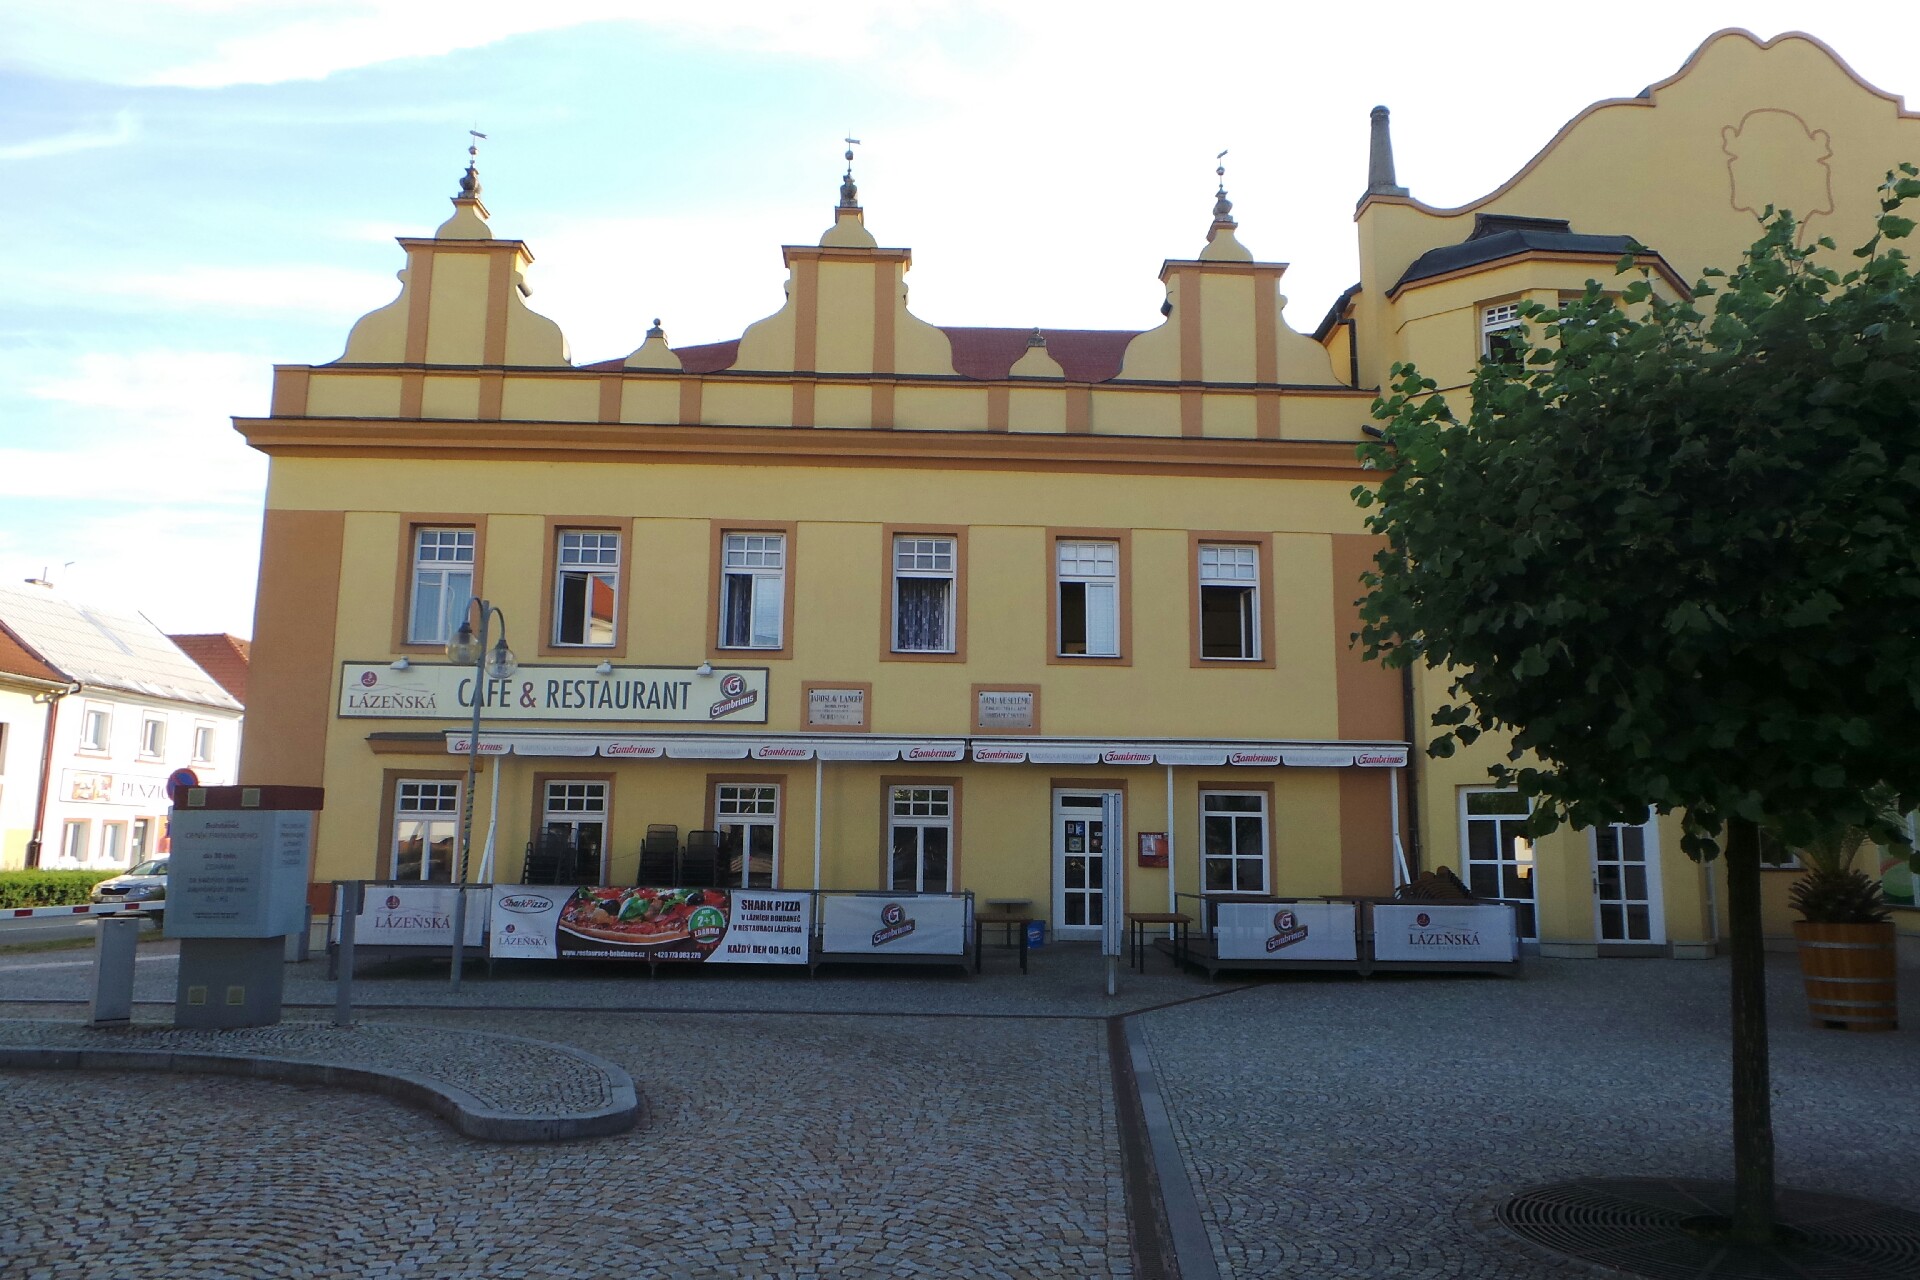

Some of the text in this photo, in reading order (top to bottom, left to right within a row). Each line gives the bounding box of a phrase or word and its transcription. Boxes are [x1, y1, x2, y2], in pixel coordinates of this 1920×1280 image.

[519, 681, 537, 708] &
[546, 679, 692, 710] RESTAURANT
[348, 693, 437, 709] LÁZEŇSKÁ
[711, 694, 755, 716] Gambrinus
[454, 740, 504, 751] Gabrinus
[607, 743, 656, 755] Gambrinus
[758, 746, 806, 758] Gambrinus
[908, 747, 957, 759] Gambrinus
[975, 748, 1024, 760] Gambrinus
[1104, 751, 1151, 762] Gambrinus
[1231, 752, 1278, 764] Gambrinus
[1357, 753, 1404, 765] Gambrinus
[503, 898, 549, 909] SharkPizza
[741, 899, 801, 911] SHARK PIZZA
[375, 914, 450, 929] LÁZEŇSKÁ
[697, 914, 716, 927] 2+1
[771, 914, 801, 922] BOHDANEČ
[774, 925, 802, 933] LÁZEŇSKÁ
[873, 924, 913, 944] Gambrinus
[499, 935, 548, 946] LÁZEŇSKÁ
[1267, 929, 1306, 950] Gambrinus
[1408, 931, 1480, 945] LÁZEŇSKÁ
[727, 944, 801, 955] KAŽDÝ DEN OD 14:00
